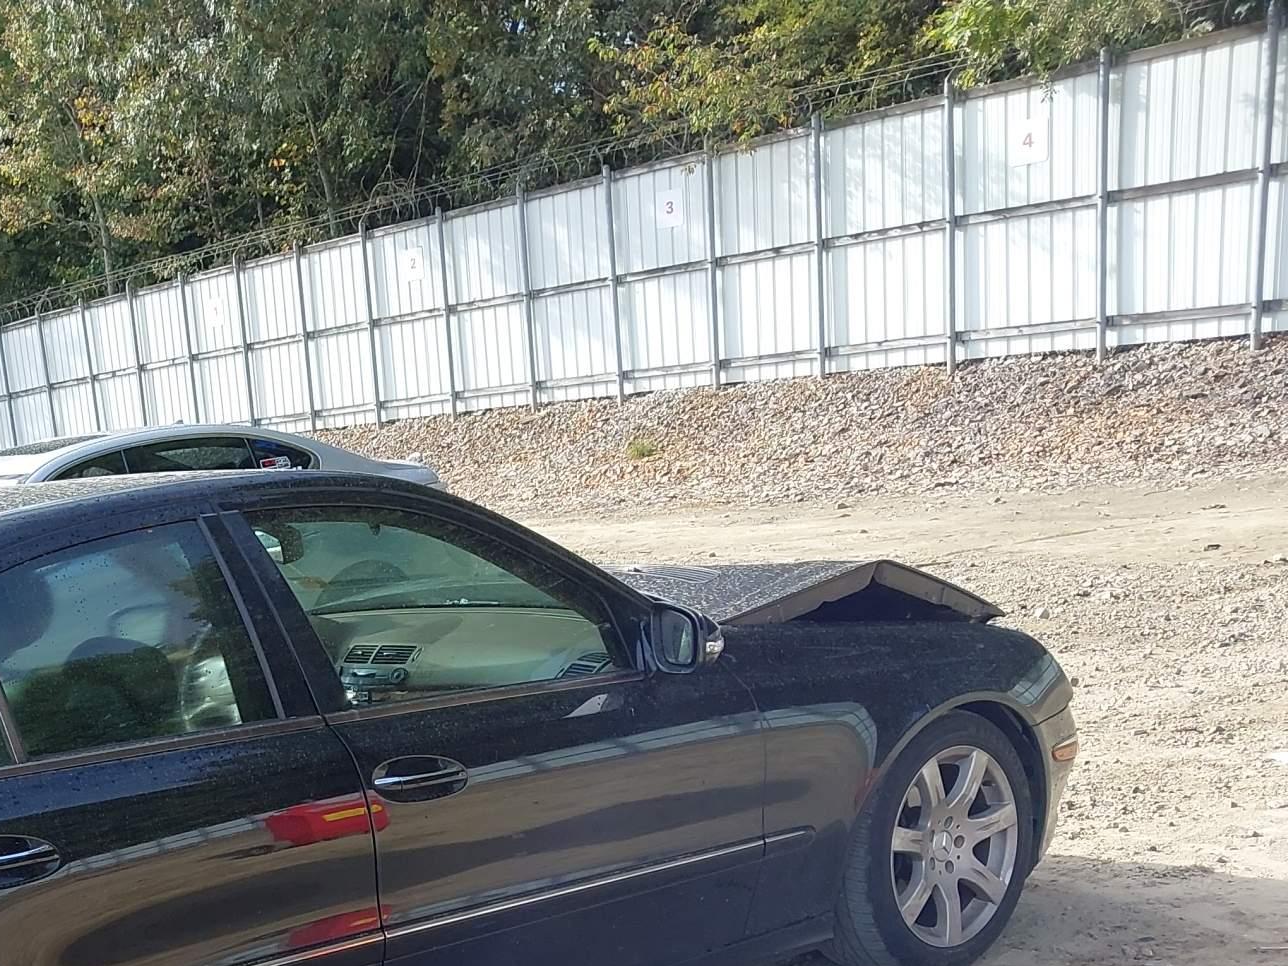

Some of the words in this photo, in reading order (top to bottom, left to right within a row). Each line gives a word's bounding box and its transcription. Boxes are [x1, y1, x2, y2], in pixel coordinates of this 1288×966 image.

[1022, 132, 1034, 148] 4
[665, 200, 674, 214] 3
[410, 257, 416, 269] 2
